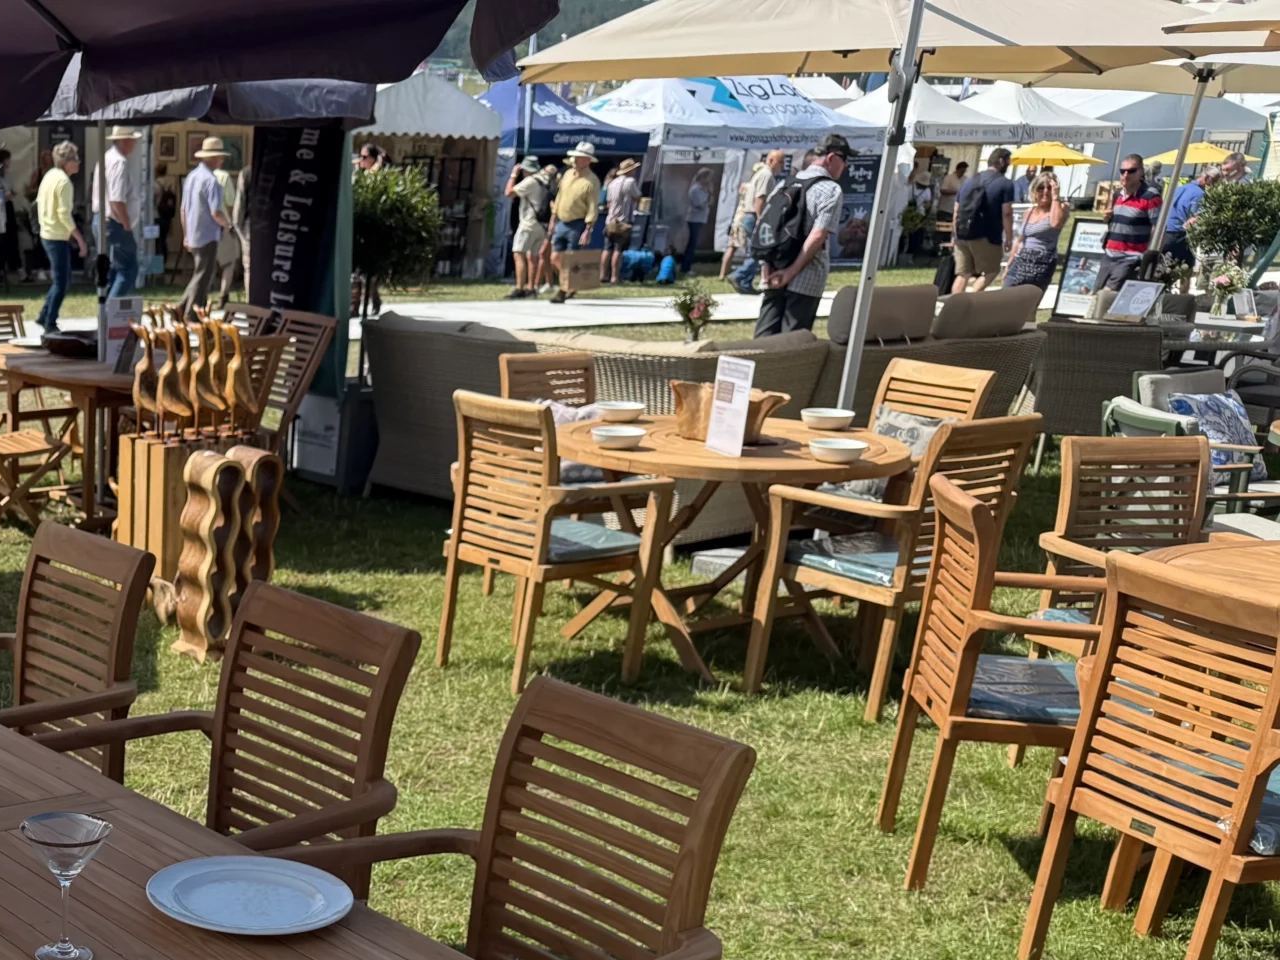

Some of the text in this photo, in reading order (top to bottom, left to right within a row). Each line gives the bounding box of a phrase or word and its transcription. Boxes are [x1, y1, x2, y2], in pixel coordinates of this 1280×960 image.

[296, 127, 322, 161] me
[935, 128, 978, 138] SHAWBURY
[982, 129, 1003, 138] WINE
[1043, 130, 1083, 139] SHAWBURY
[1086, 130, 1105, 138] WINE
[270, 193, 313, 284] Leisure
